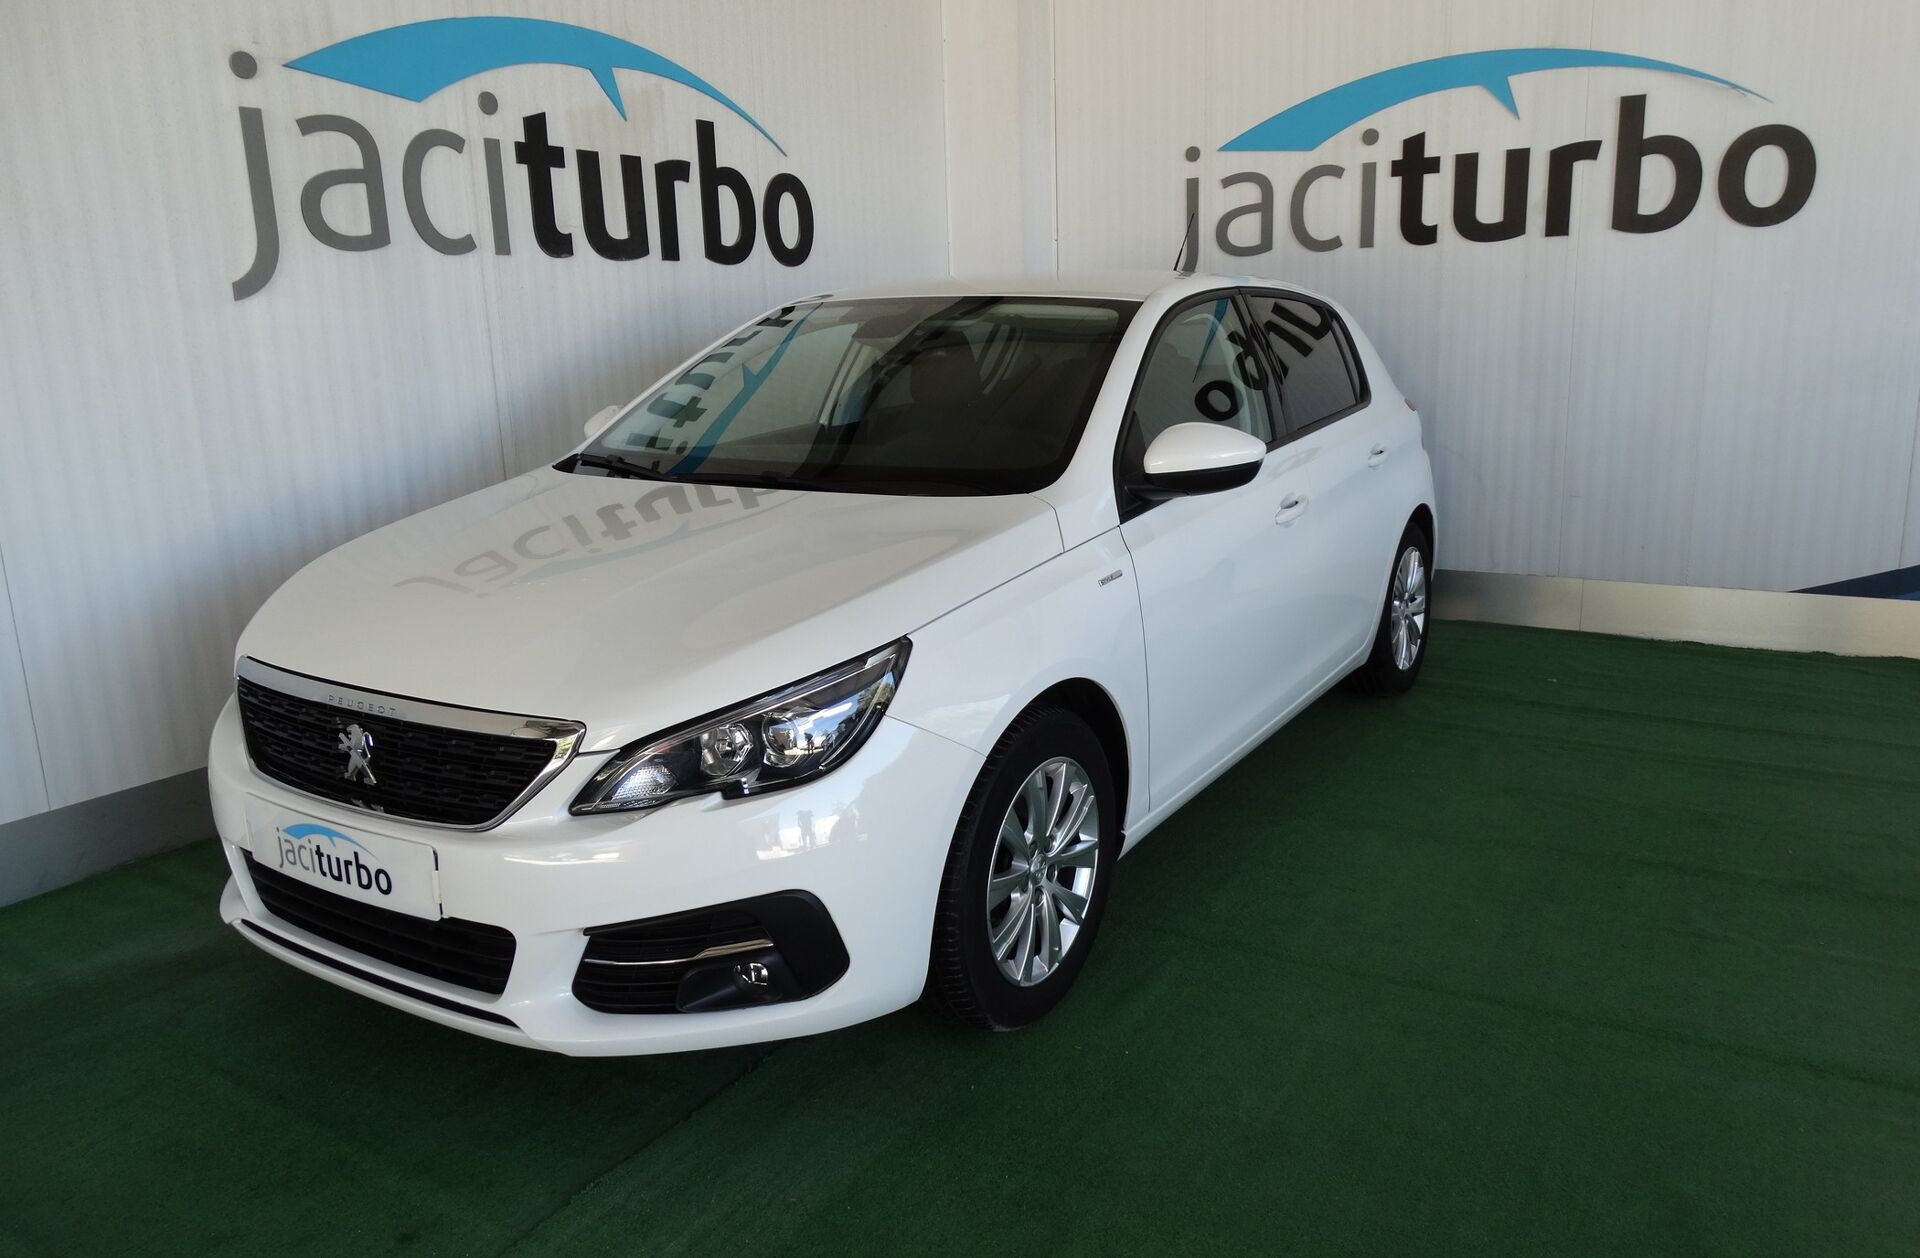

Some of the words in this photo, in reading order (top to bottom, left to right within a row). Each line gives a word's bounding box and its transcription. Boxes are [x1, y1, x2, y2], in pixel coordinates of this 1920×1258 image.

[229, 50, 815, 301] jaciturbo
[1182, 93, 1817, 272] jaciturbo
[328, 694, 396, 716] PEUGEOT
[276, 826, 393, 896] jaciturbo
